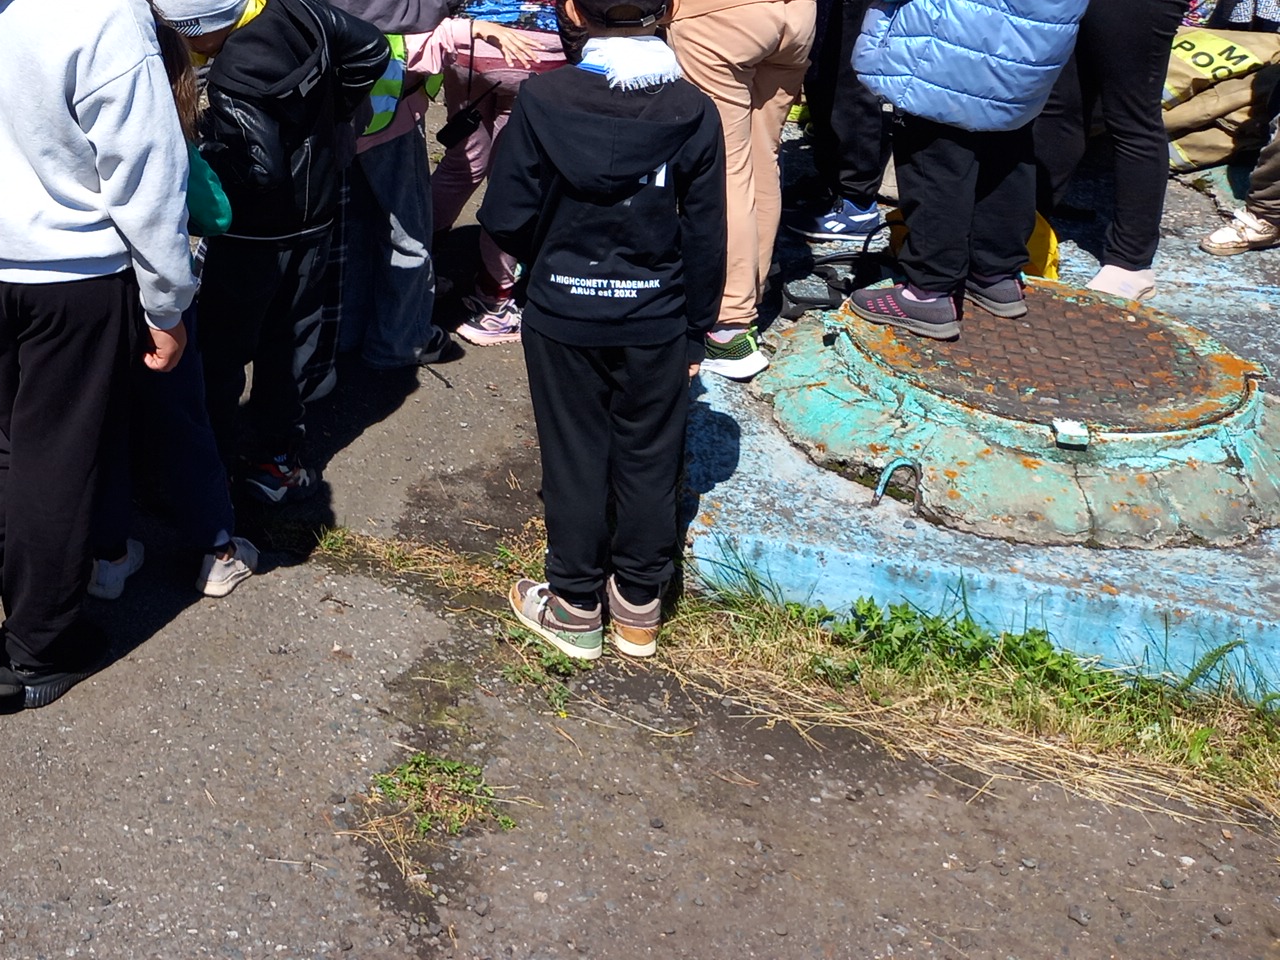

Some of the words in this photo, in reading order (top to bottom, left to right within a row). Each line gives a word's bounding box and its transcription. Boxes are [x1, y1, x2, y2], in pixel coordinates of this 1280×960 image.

[550, 273, 556, 283] A
[556, 274, 608, 288] HIGHCONETY
[610, 279, 661, 289] TRADEMARK
[570, 286, 596, 296] ARUS
[597, 289, 613, 297] est
[613, 289, 638, 298] 20XX
